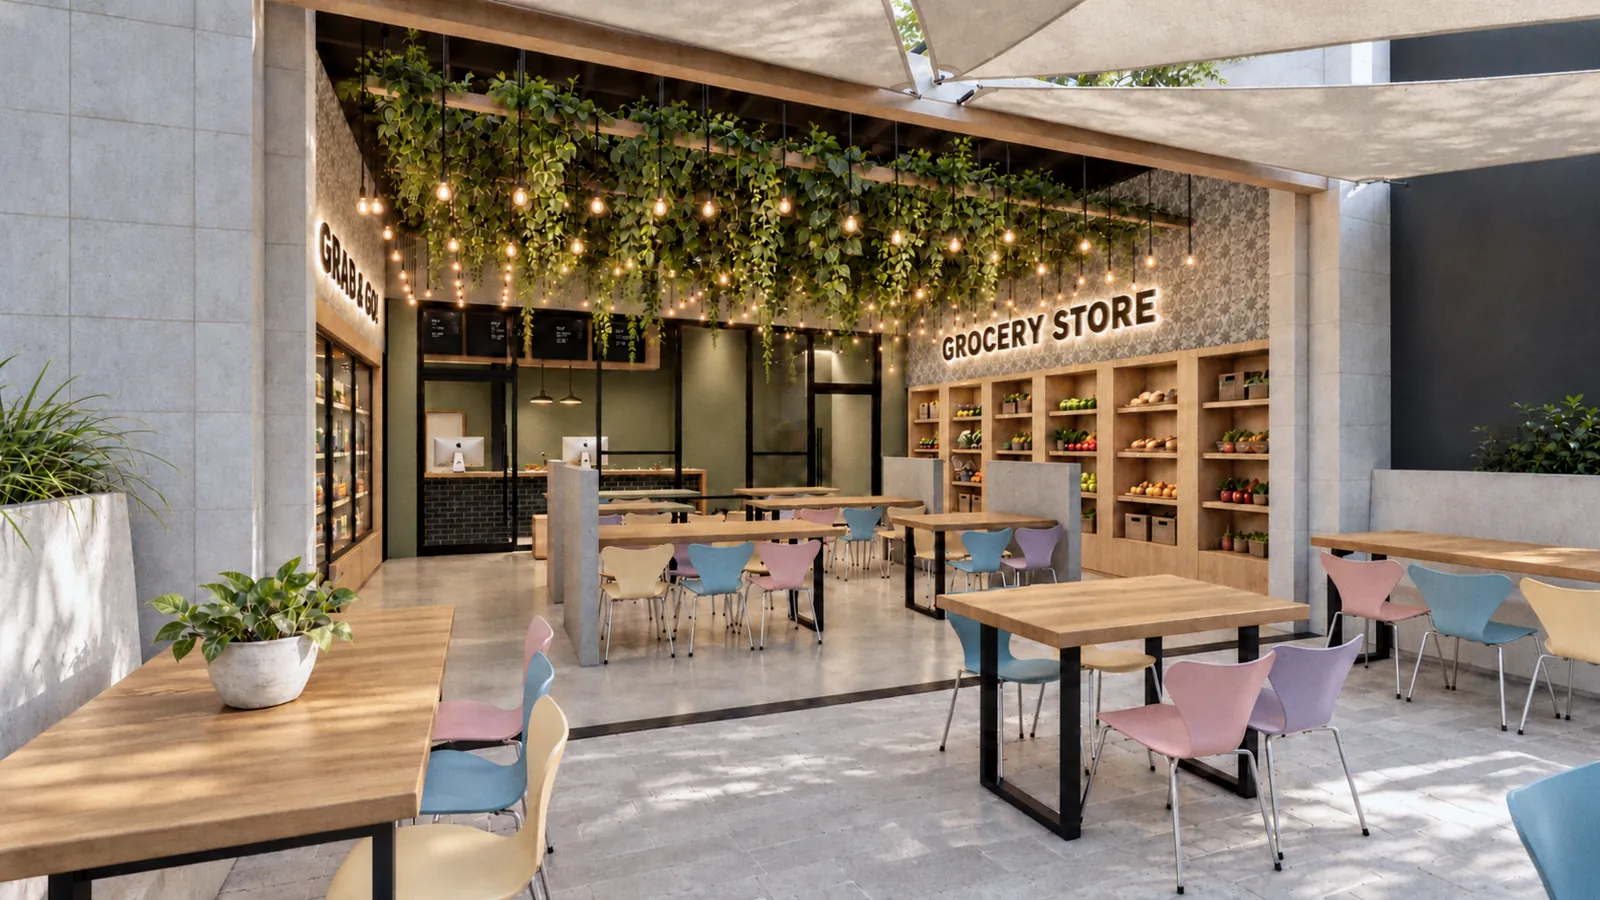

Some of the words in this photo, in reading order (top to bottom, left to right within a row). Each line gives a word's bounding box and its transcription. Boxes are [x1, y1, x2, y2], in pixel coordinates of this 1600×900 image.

[319, 222, 356, 300] GRAB
[357, 272, 363, 308] &
[365, 281, 378, 324] GO!
[942, 314, 1045, 361] GROCERY
[1052, 289, 1157, 340] STORE
